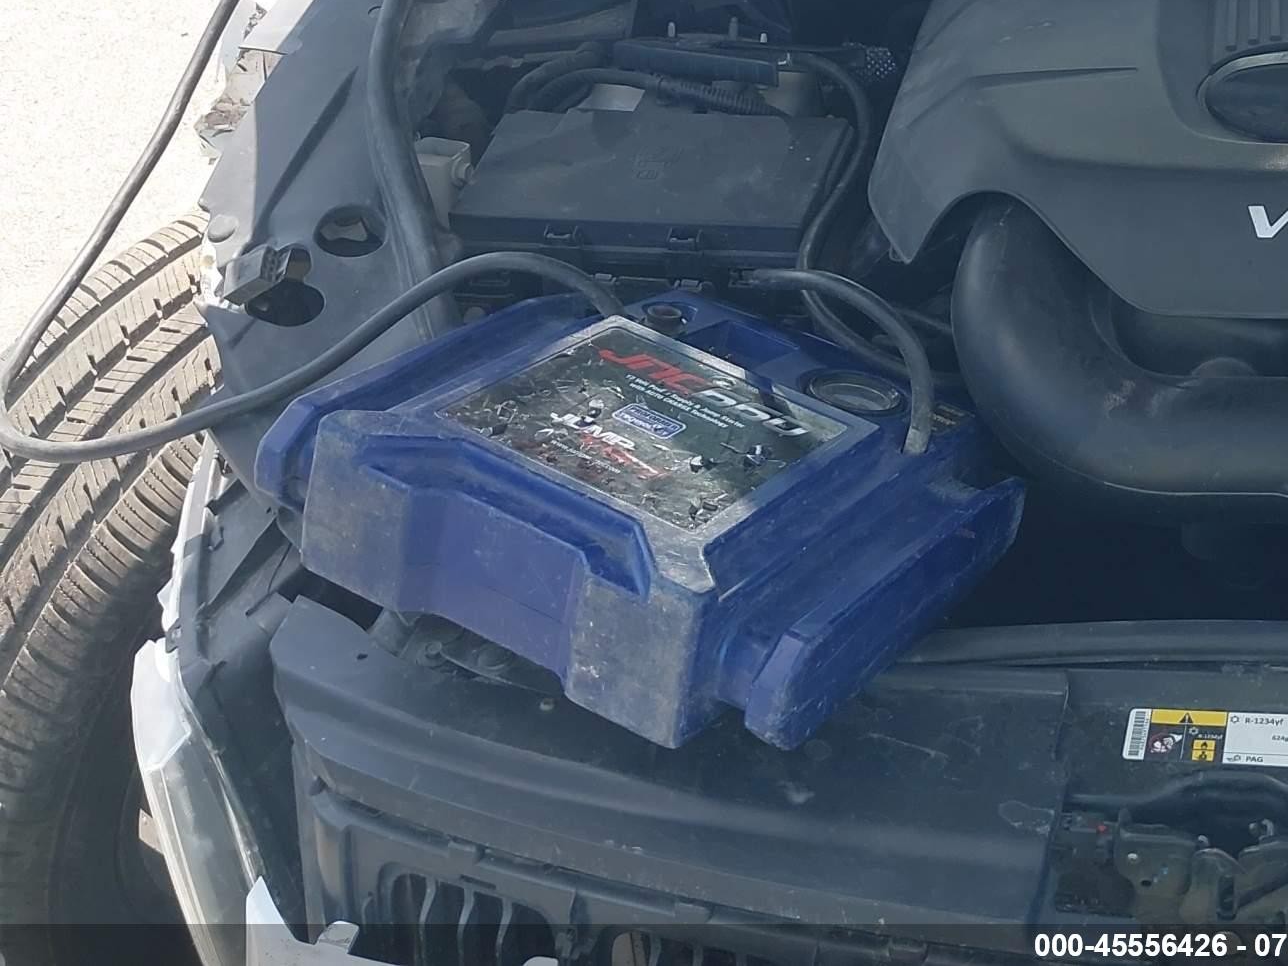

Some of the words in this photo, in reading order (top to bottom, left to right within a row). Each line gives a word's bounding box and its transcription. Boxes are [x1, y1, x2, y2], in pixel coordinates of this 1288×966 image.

[629, 383, 647, 392] with
[645, 389, 665, 400] AUTO
[662, 397, 692, 412] CHARGE
[690, 409, 729, 428] Technology
[634, 378, 650, 387] Volt
[670, 393, 695, 407] Supply
[699, 407, 721, 418] Jump
[1244, 718, 1284, 727] R-1234yf
[1245, 755, 1264, 764] PAG
